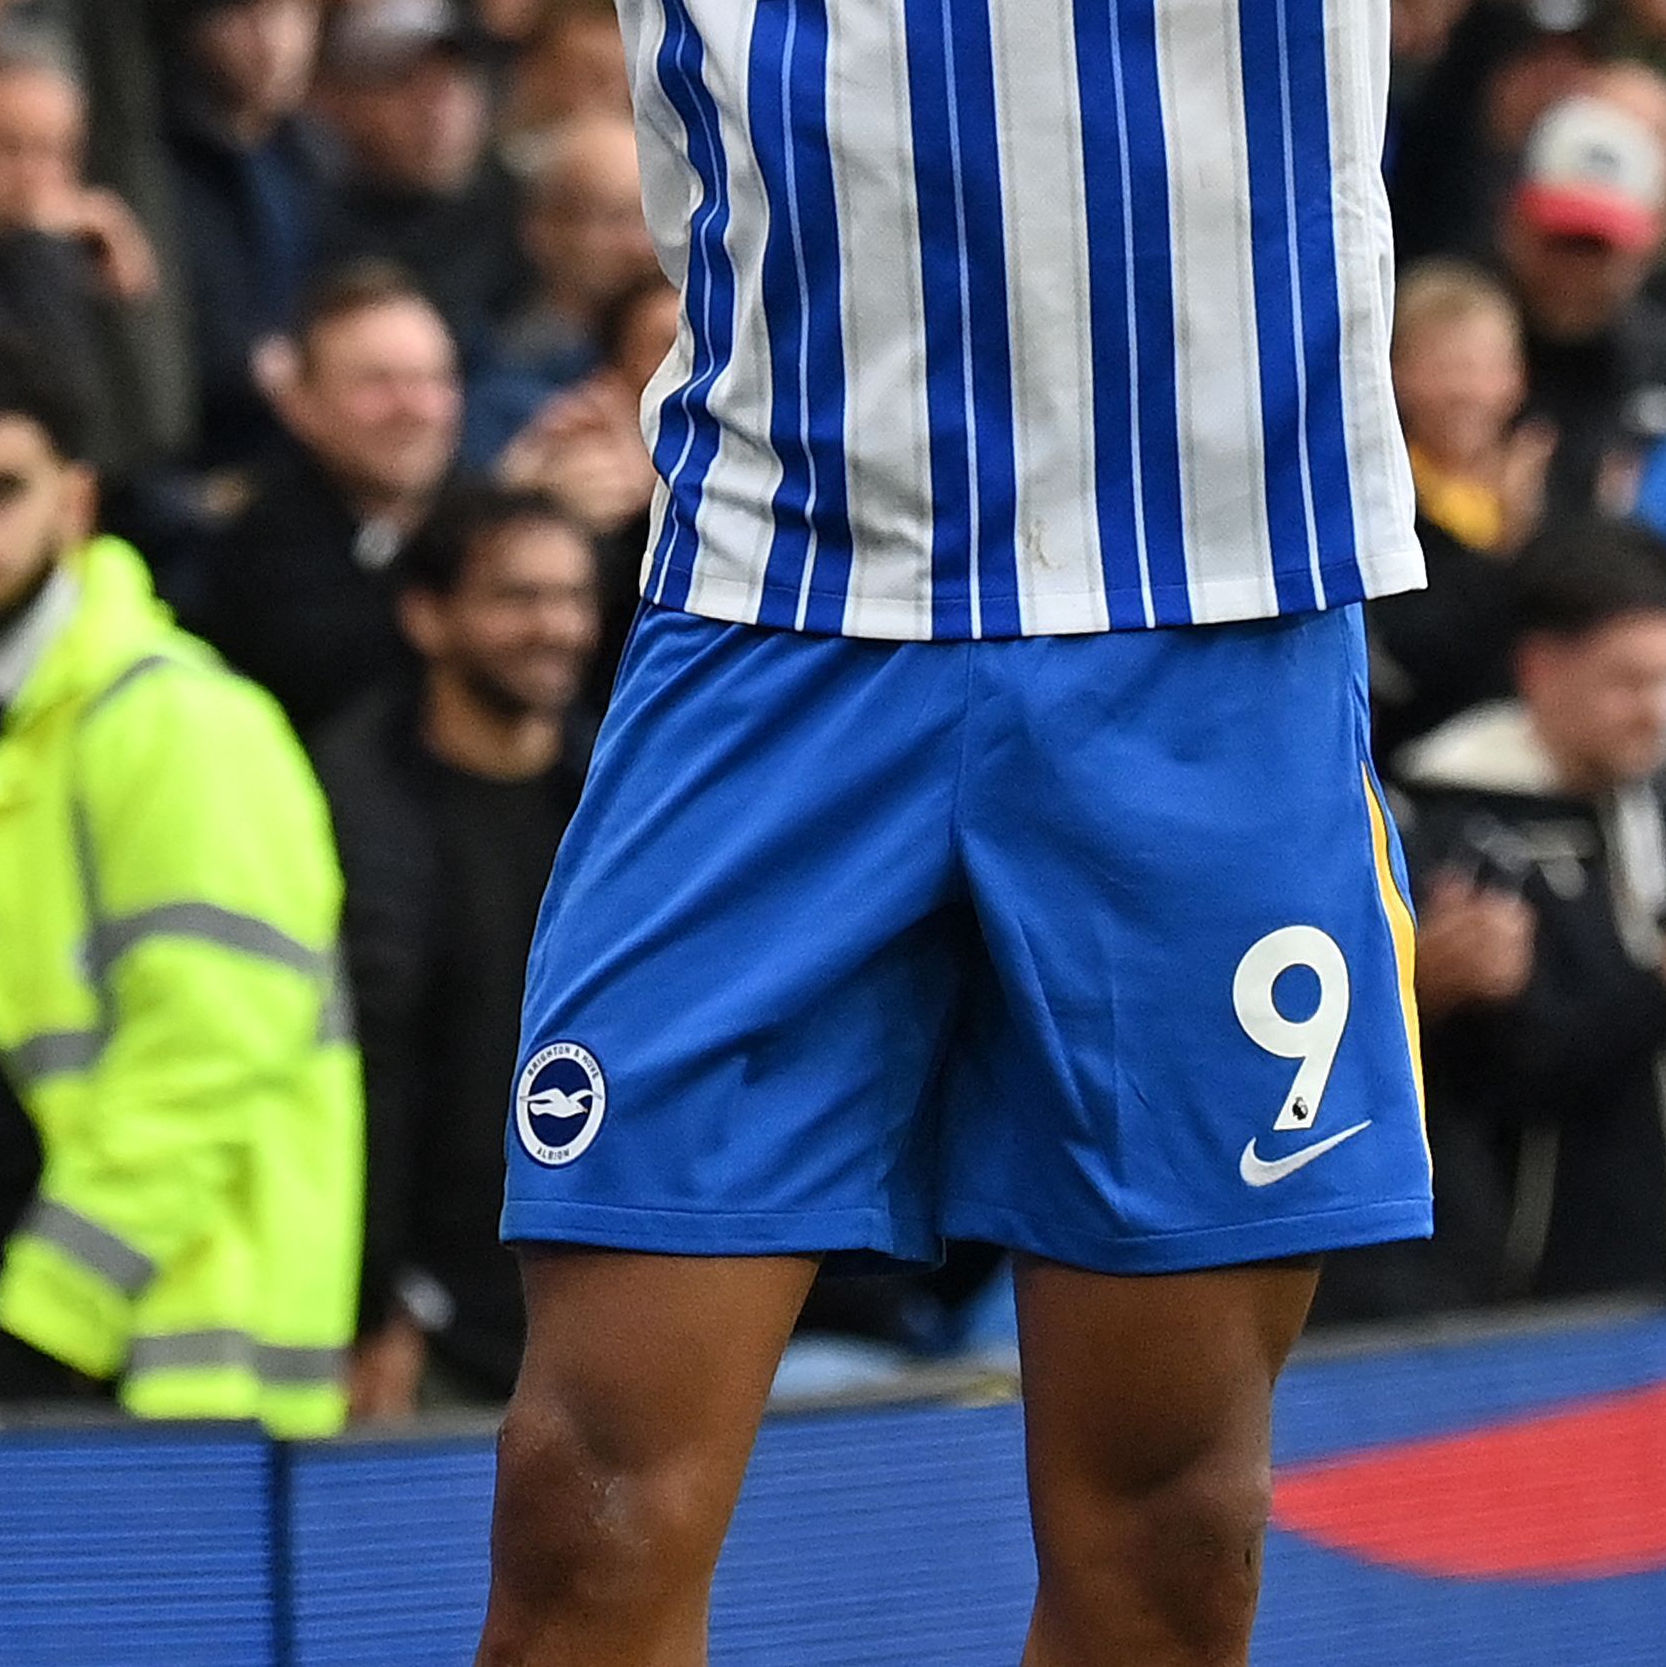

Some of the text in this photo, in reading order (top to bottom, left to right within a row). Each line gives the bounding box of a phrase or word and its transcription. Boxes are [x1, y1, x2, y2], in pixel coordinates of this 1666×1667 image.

[1232, 924, 1350, 1131] 9
[527, 1046, 570, 1076] BRIGHTON
[536, 1147, 570, 1160] ALBION
